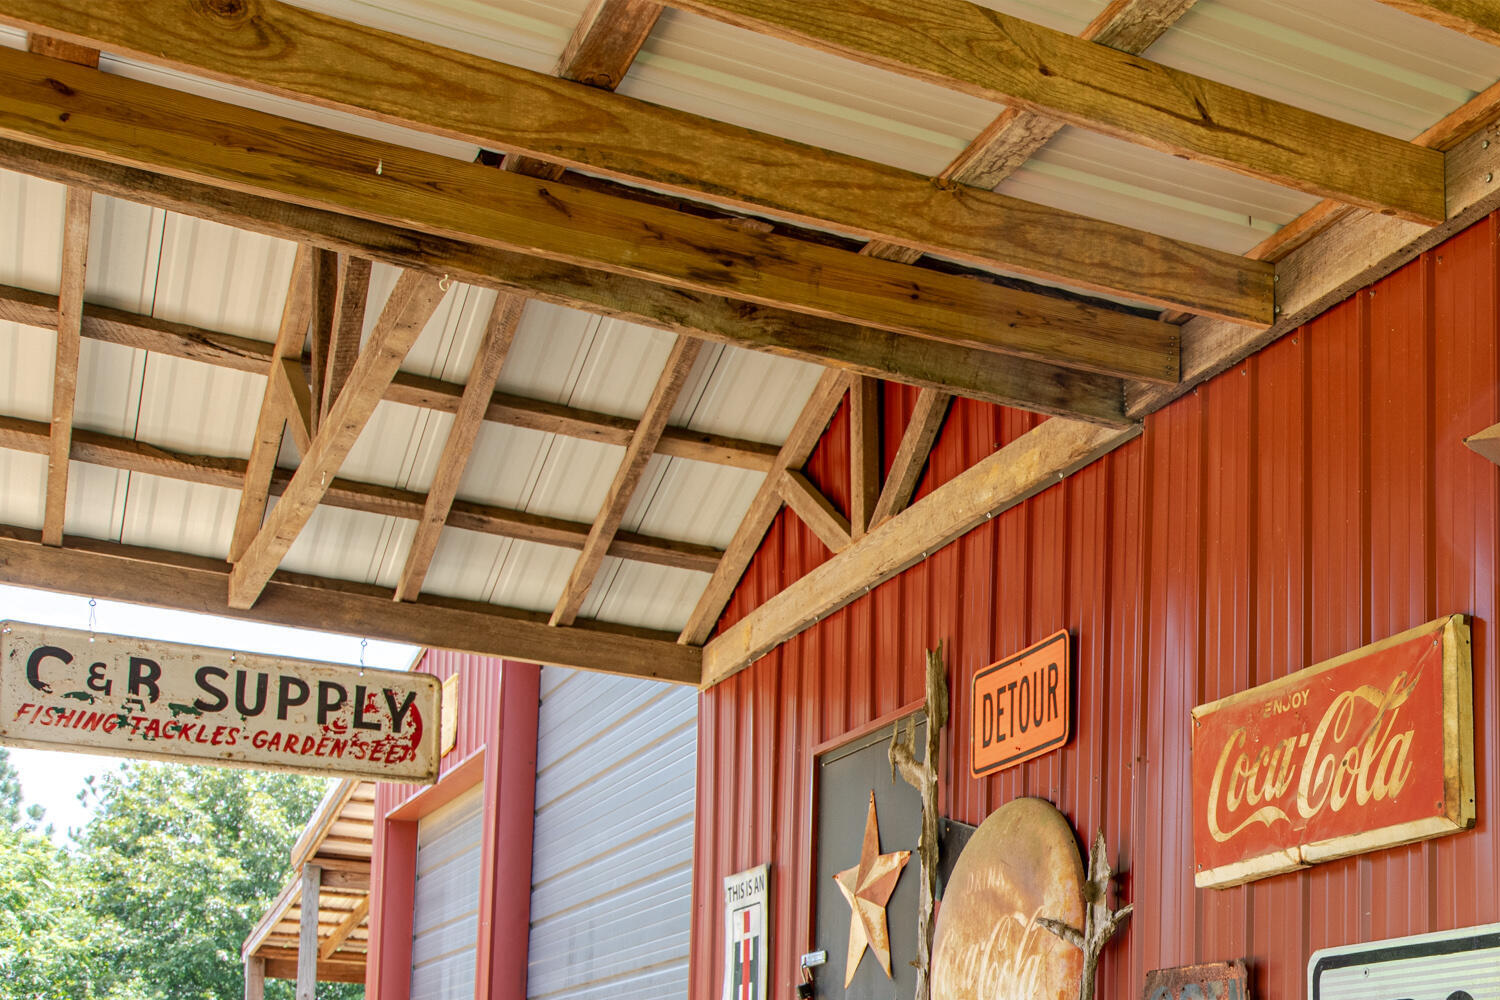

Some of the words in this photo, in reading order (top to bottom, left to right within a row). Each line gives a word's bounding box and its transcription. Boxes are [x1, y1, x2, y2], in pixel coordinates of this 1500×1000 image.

[13, 703, 118, 733] FISHING
[26, 645, 73, 693] C
[87, 662, 112, 696] &
[195, 666, 417, 733] SUPPLY
[982, 662, 1060, 749] DETOUR
[1263, 689, 1310, 718] ENJOY
[1207, 667, 1422, 842] Coca-Cola
[727, 884, 745, 902] THIS
[745, 880, 753, 896] IS
[754, 876, 765, 894] AN
